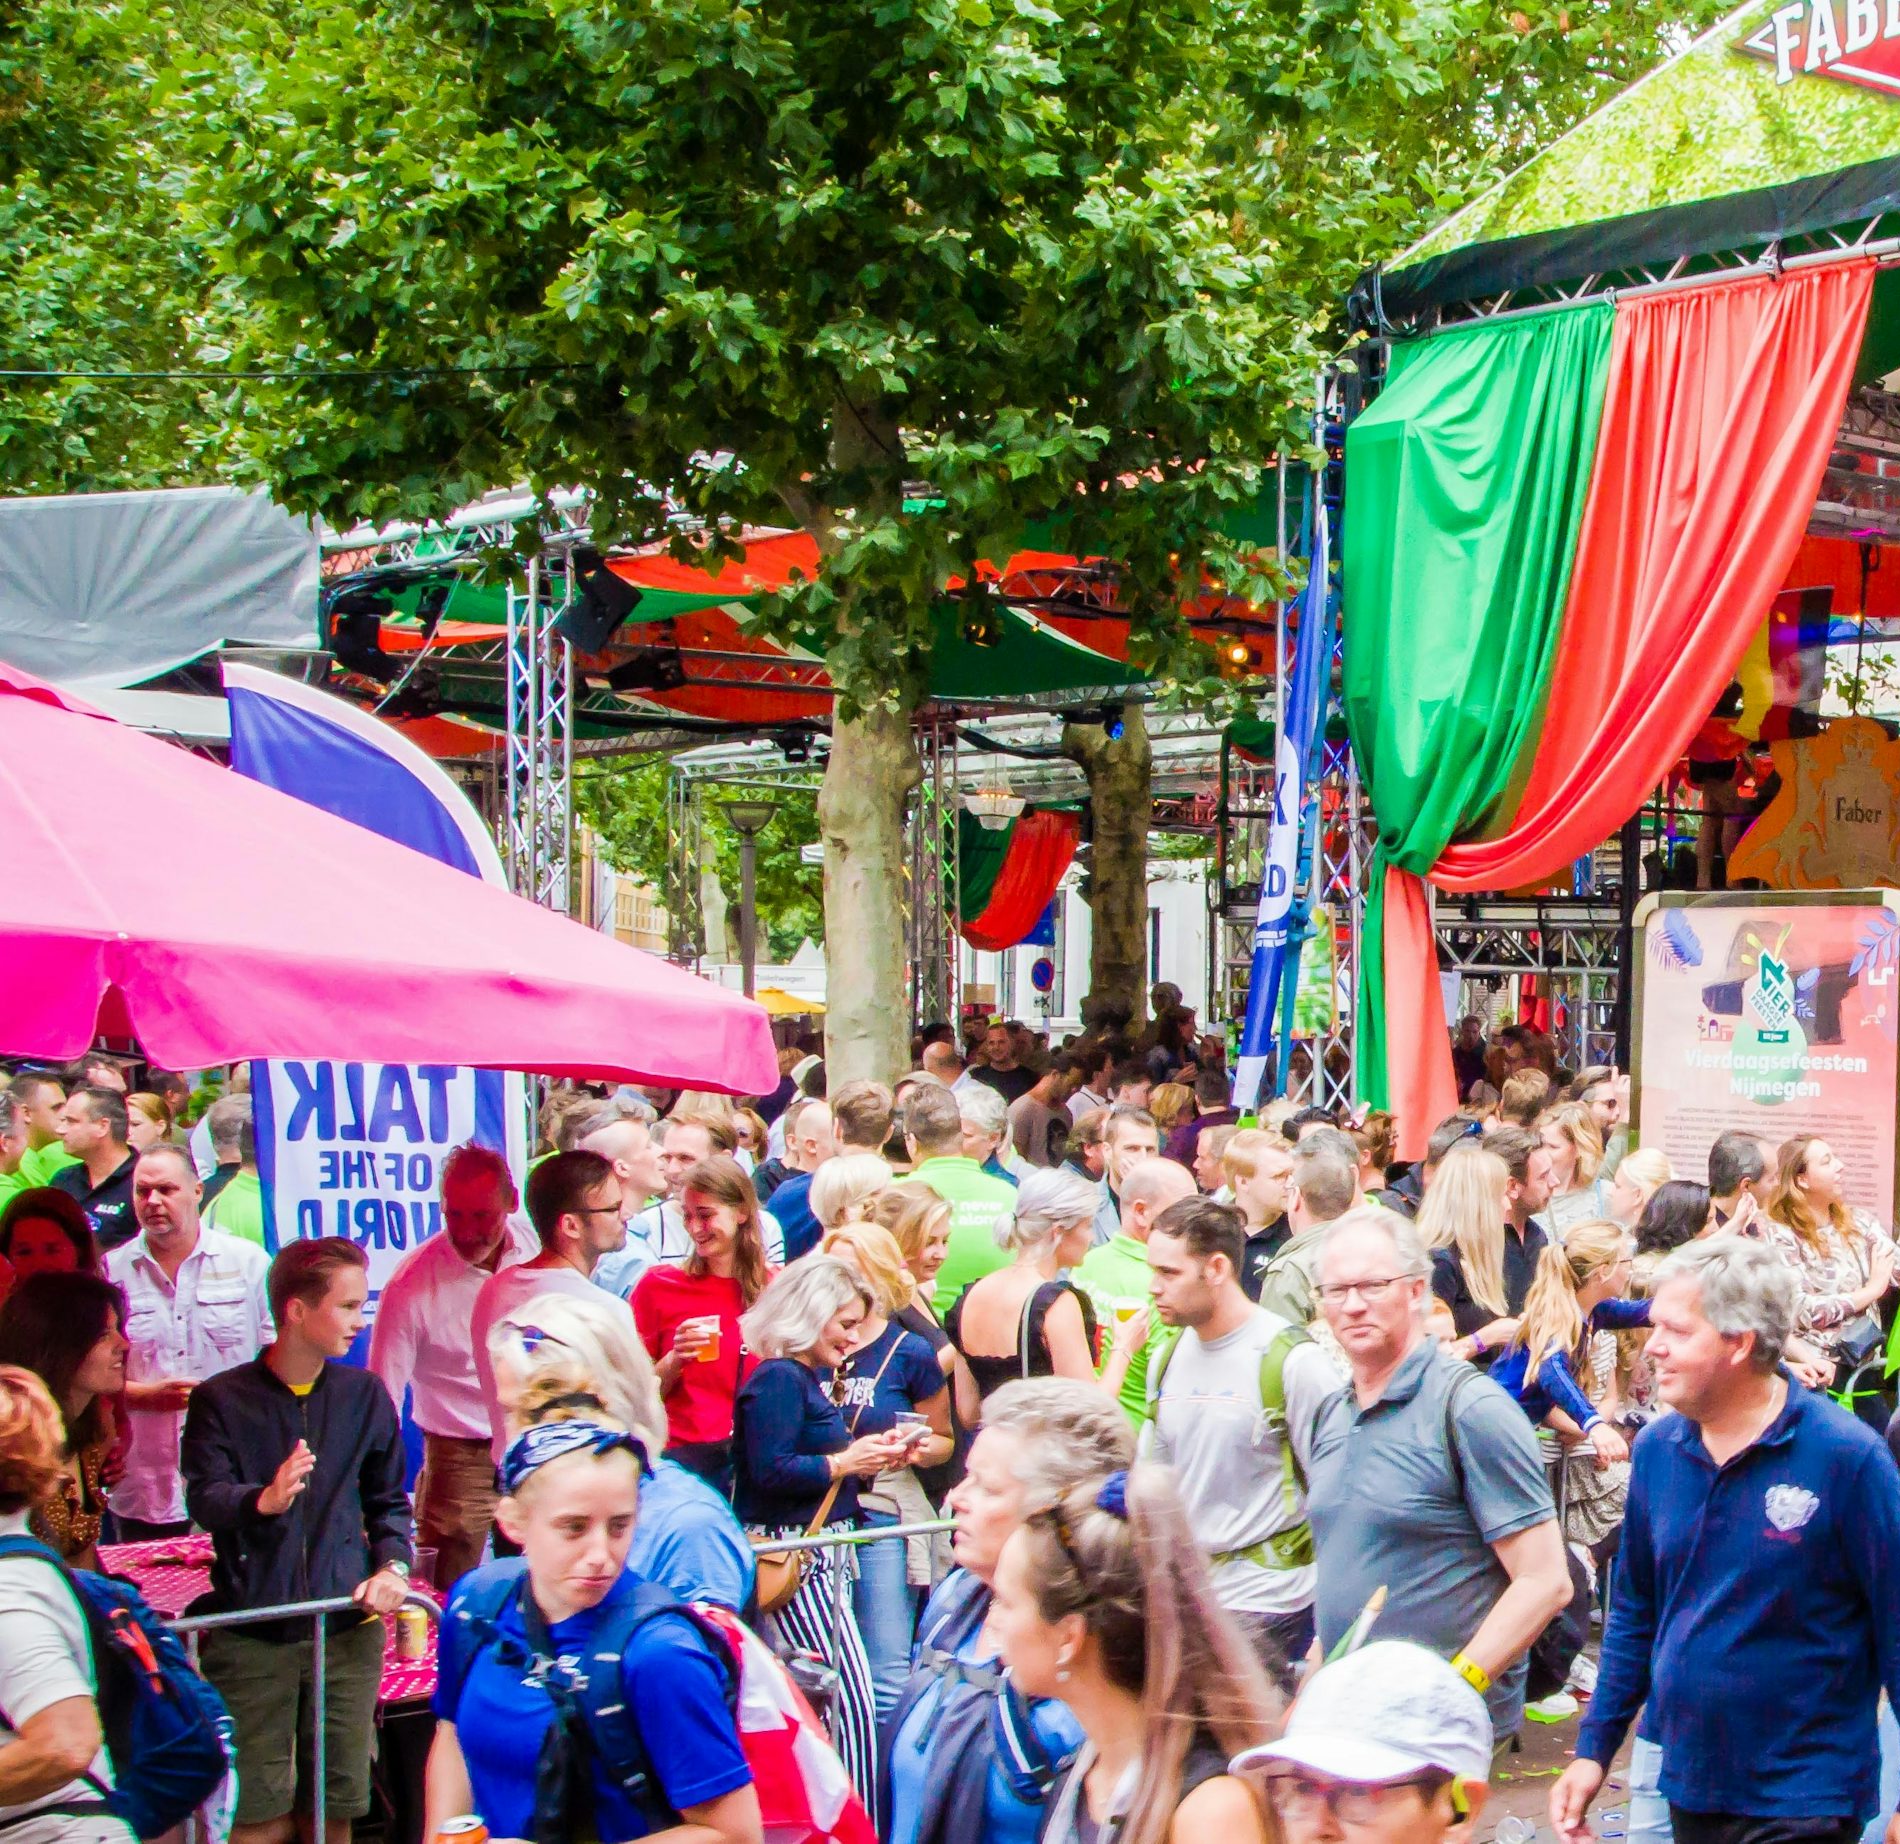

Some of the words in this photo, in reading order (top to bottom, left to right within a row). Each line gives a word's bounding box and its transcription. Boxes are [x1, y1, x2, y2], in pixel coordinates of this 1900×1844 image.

[1835, 796, 1882, 824] Faber
[1684, 1049, 1868, 1074] Vierdaagsefeesten
[1728, 1077, 1822, 1102] Nijmegen
[958, 1211, 995, 1226] alon
